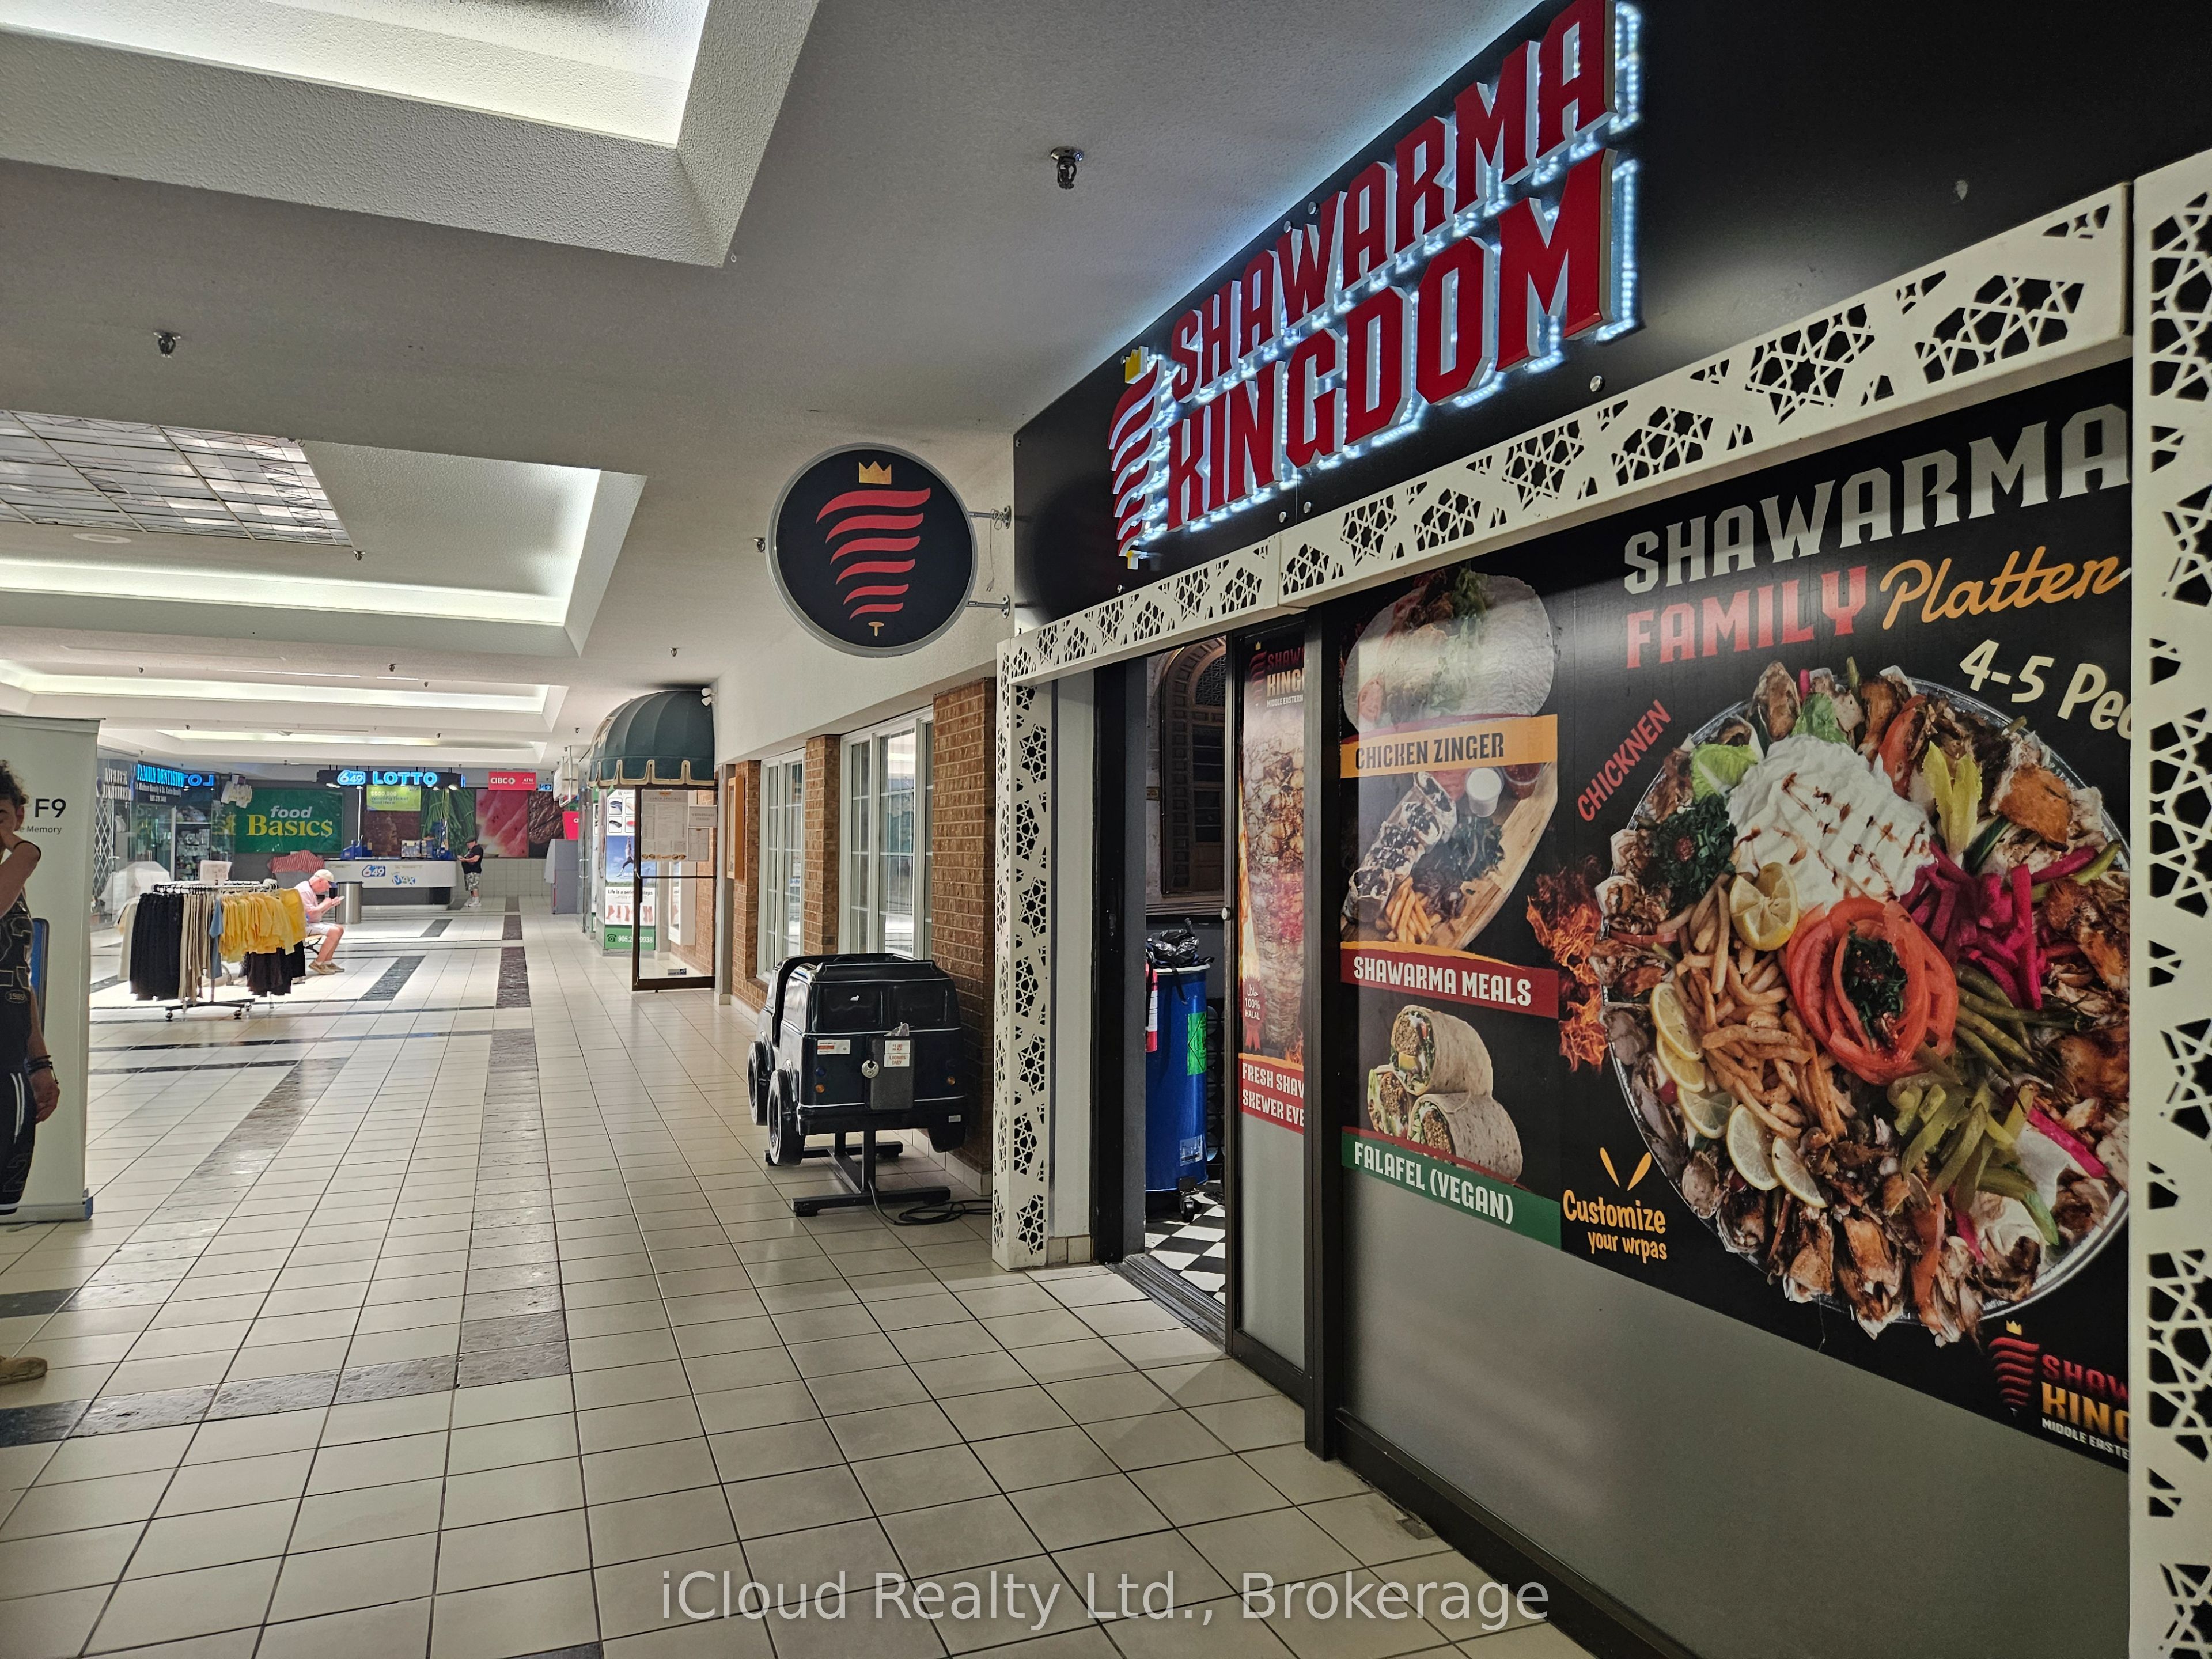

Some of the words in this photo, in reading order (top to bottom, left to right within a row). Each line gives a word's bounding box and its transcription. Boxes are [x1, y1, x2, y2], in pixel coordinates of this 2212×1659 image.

[1171, 0, 1617, 403] SHAWARMA
[1167, 149, 1617, 531] KINGDOM
[1624, 403, 2130, 595] SHAWARMA
[1627, 565, 1868, 669] FAMILY
[1959, 639, 2055, 703] 4-5
[1355, 740, 1428, 770] CHICKEN
[1434, 732, 1504, 763] ZINGER
[1578, 699, 1671, 821] CHICKNEN
[137, 764, 157, 783] FAMILY
[157, 768, 184, 787] DENTISTRY
[372, 771, 438, 786] LOTTO
[35, 798, 66, 818] F9
[270, 806, 312, 818] food
[26, 826, 62, 835] Memory
[1354, 956, 1456, 995] SHAWARMA
[1461, 971, 1531, 1006] MEALS
[1245, 998, 1260, 1010] 100%
[1245, 1009, 1260, 1020] HALAL
[1242, 1062, 1273, 1088] FRESH
[1242, 1089, 1284, 1119] SKEWER
[1355, 1141, 1425, 1190] FALAFEL
[1430, 1168, 1513, 1224] (VEGAN)
[1563, 1190, 1666, 1234] Customize
[1588, 1232, 1618, 1254] your
[1622, 1237, 1667, 1264] wrpas
[2042, 1417, 2087, 1444] MIDDLE
